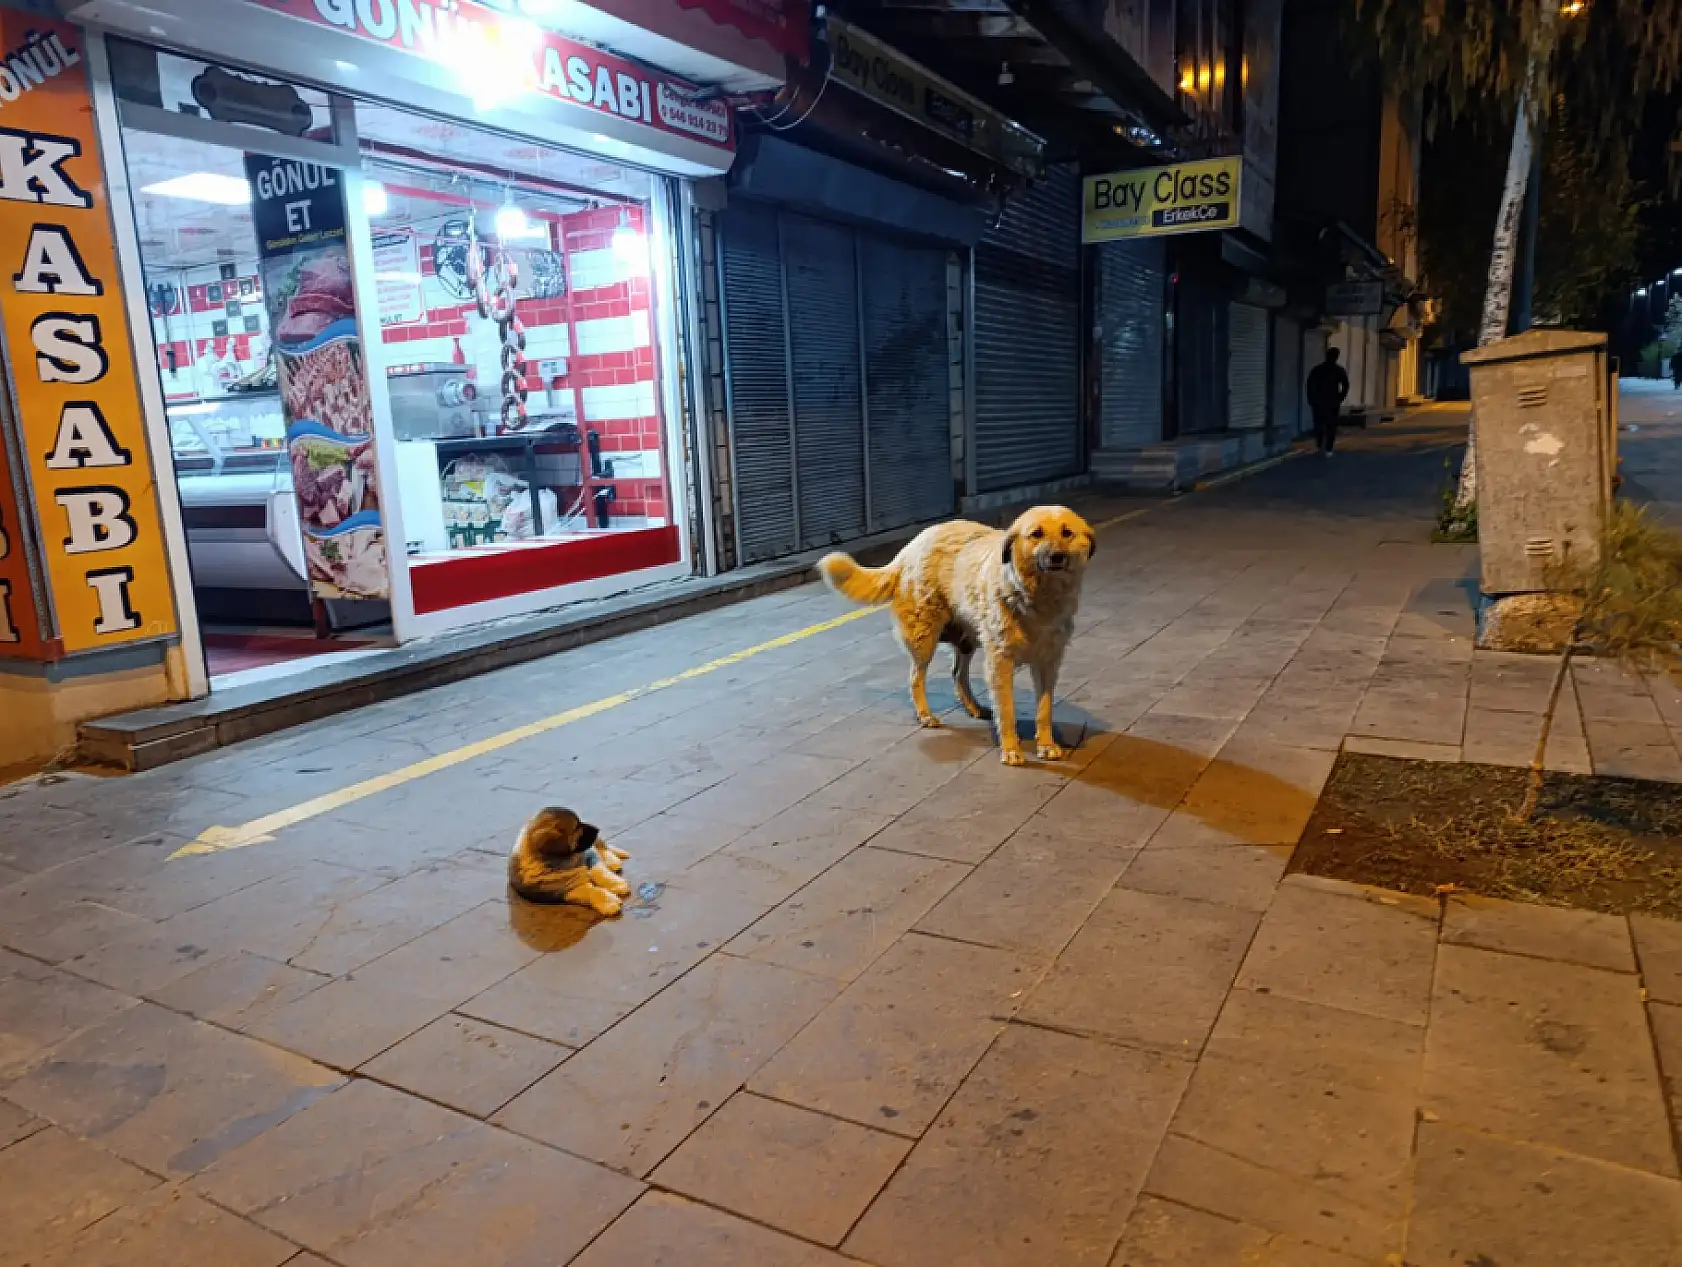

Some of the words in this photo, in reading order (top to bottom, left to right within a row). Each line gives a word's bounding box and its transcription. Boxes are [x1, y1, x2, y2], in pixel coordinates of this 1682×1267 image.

[538, 46, 652, 123] ASABI
[285, 199, 312, 232] ET
[1094, 178, 1147, 213] Bay
[1153, 169, 1231, 204] Class
[0, 126, 142, 635] KASABI
